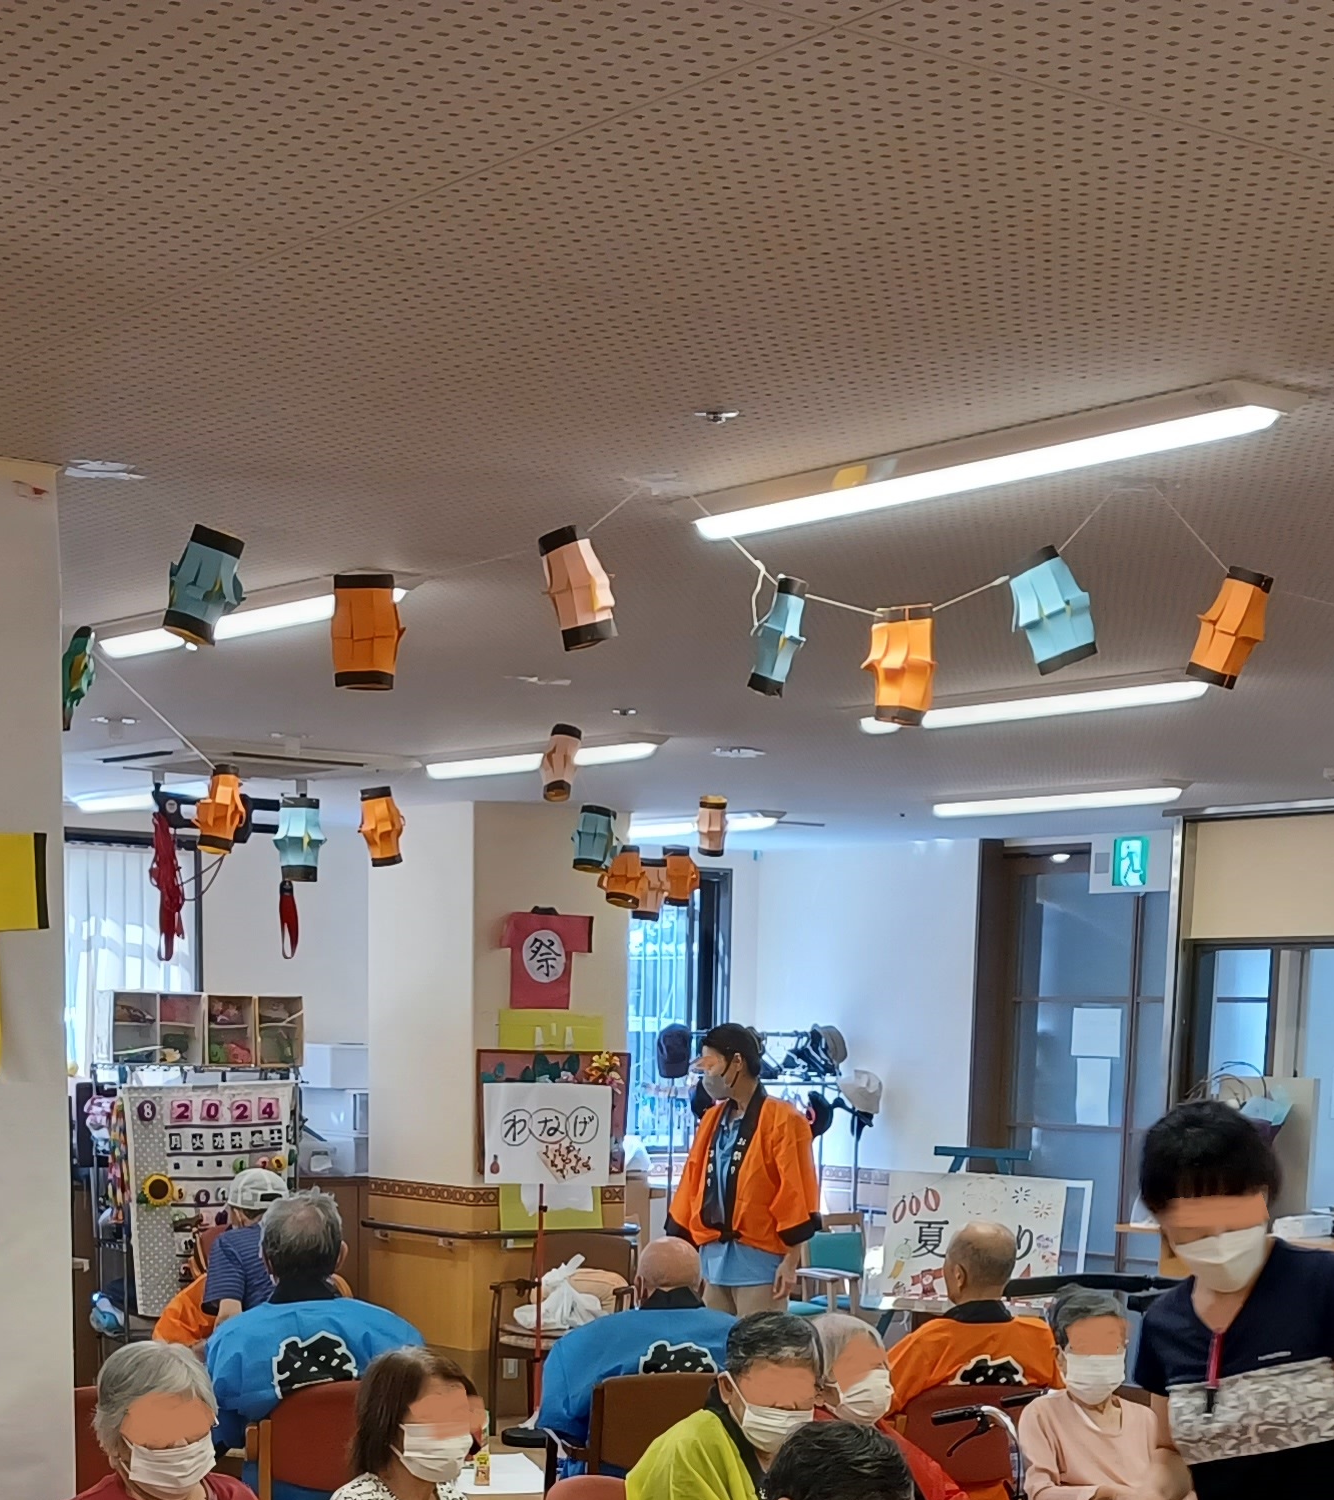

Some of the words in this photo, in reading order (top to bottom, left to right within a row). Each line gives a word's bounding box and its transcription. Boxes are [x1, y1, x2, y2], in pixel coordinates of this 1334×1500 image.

[528, 936, 562, 978] 祭
[143, 1103, 152, 1118] 8
[176, 1103, 274, 1119] 2024
[504, 1115, 595, 1141] わなげ
